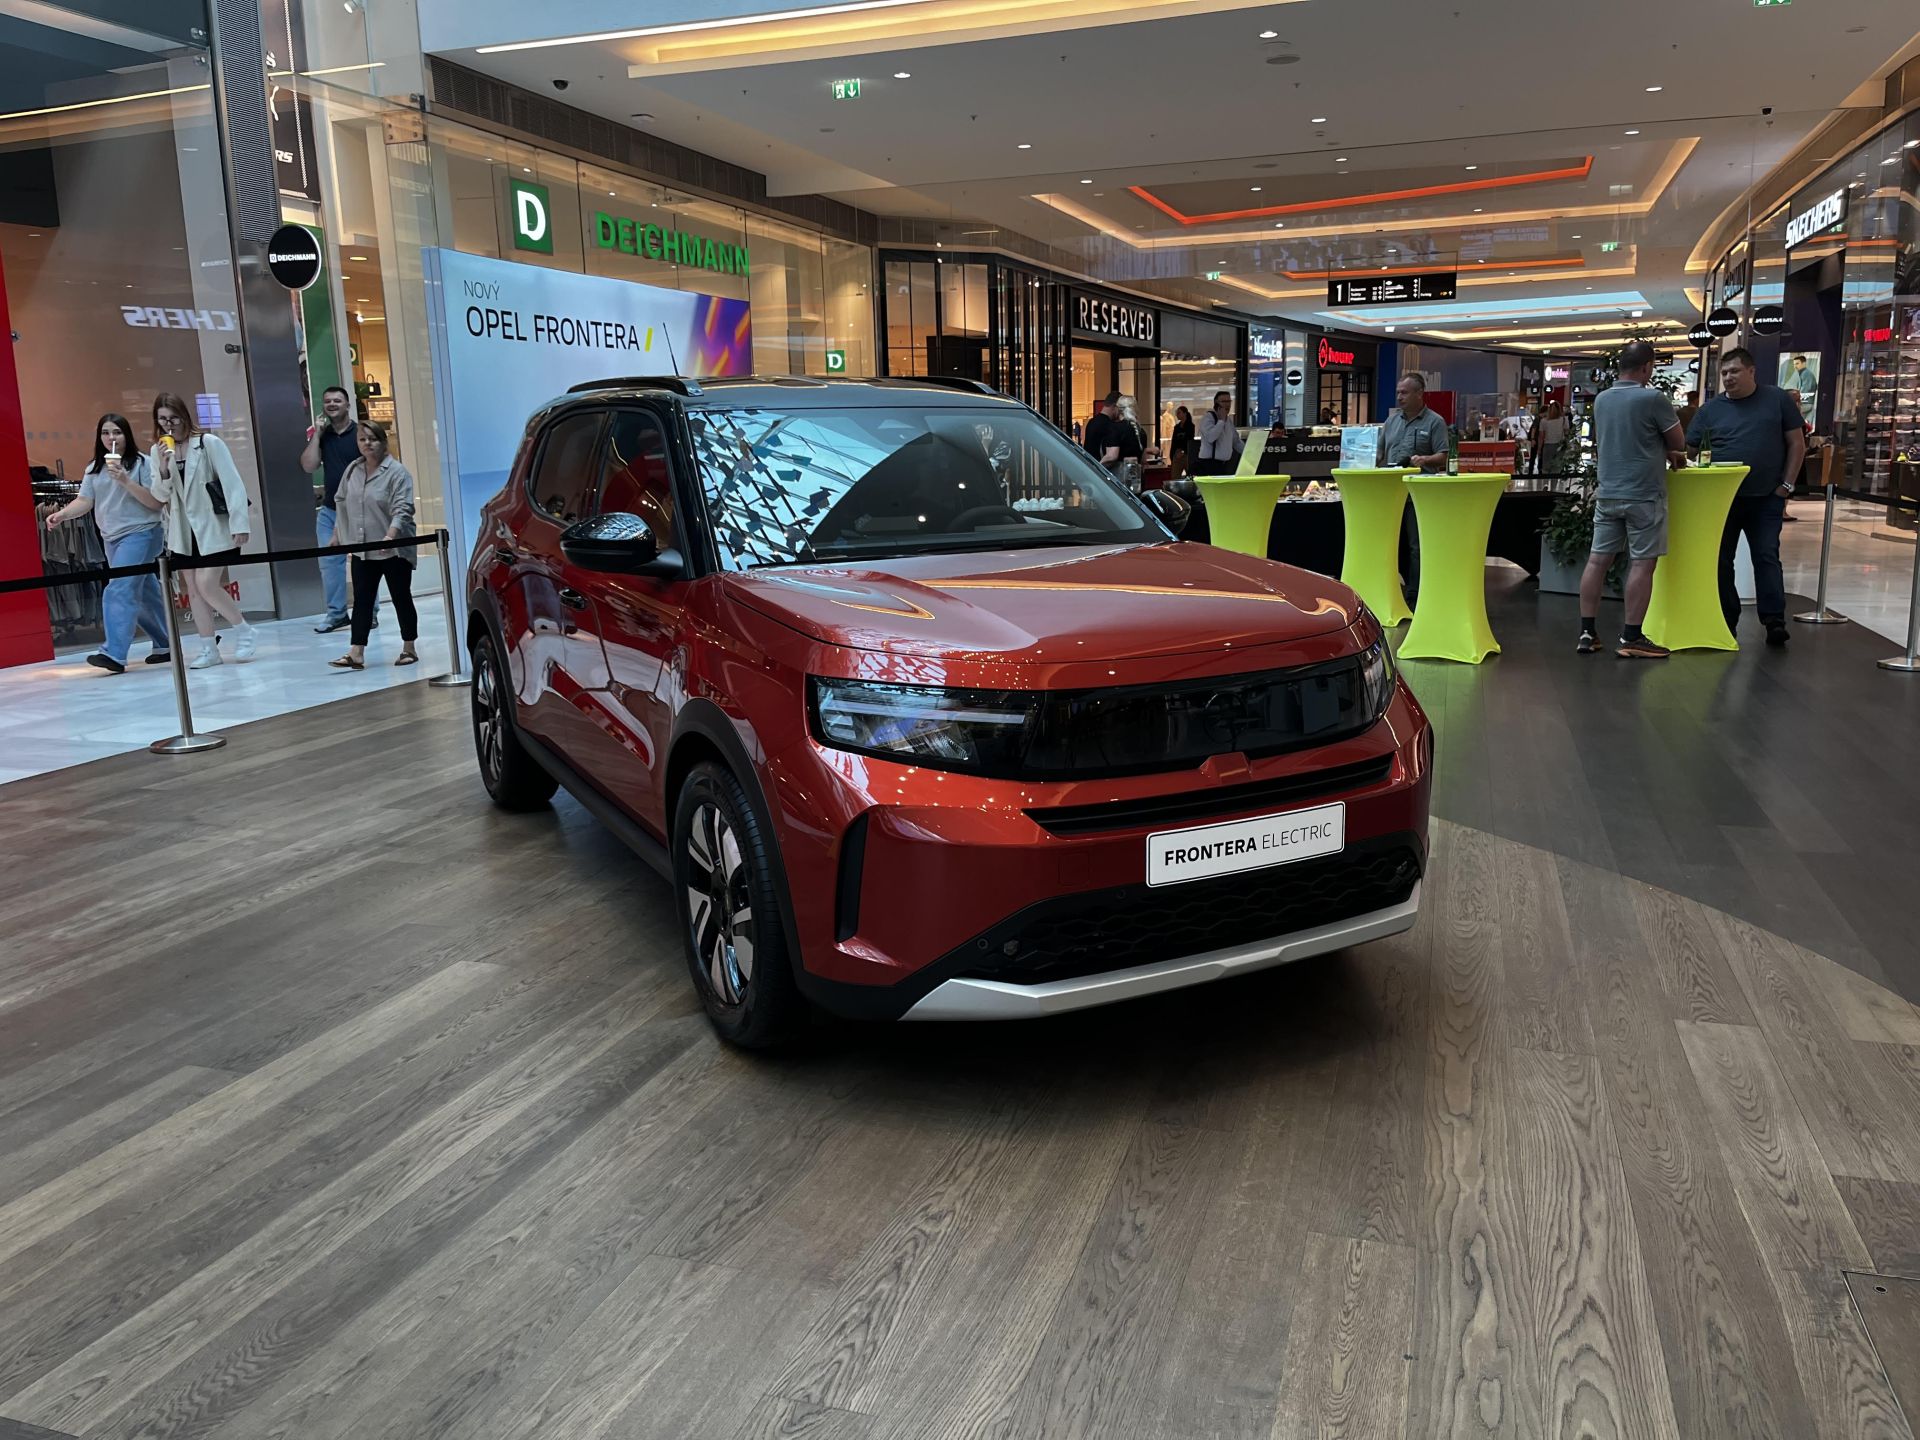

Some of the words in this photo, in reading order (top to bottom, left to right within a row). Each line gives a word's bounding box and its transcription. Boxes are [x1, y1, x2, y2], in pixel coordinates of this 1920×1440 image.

[517, 190, 547, 241] D
[1784, 188, 1844, 250] SKECHERS
[595, 211, 750, 277] DEICHMANN
[463, 279, 500, 301] NOVÝ
[1336, 284, 1343, 302] 1
[466, 306, 528, 342] OPEL
[533, 314, 640, 351] FRONTERA
[1080, 297, 1154, 341] RESERVED
[1296, 443, 1341, 453] Service
[1164, 837, 1257, 866] FRONTERA
[1262, 822, 1333, 850] ELECTRIC
